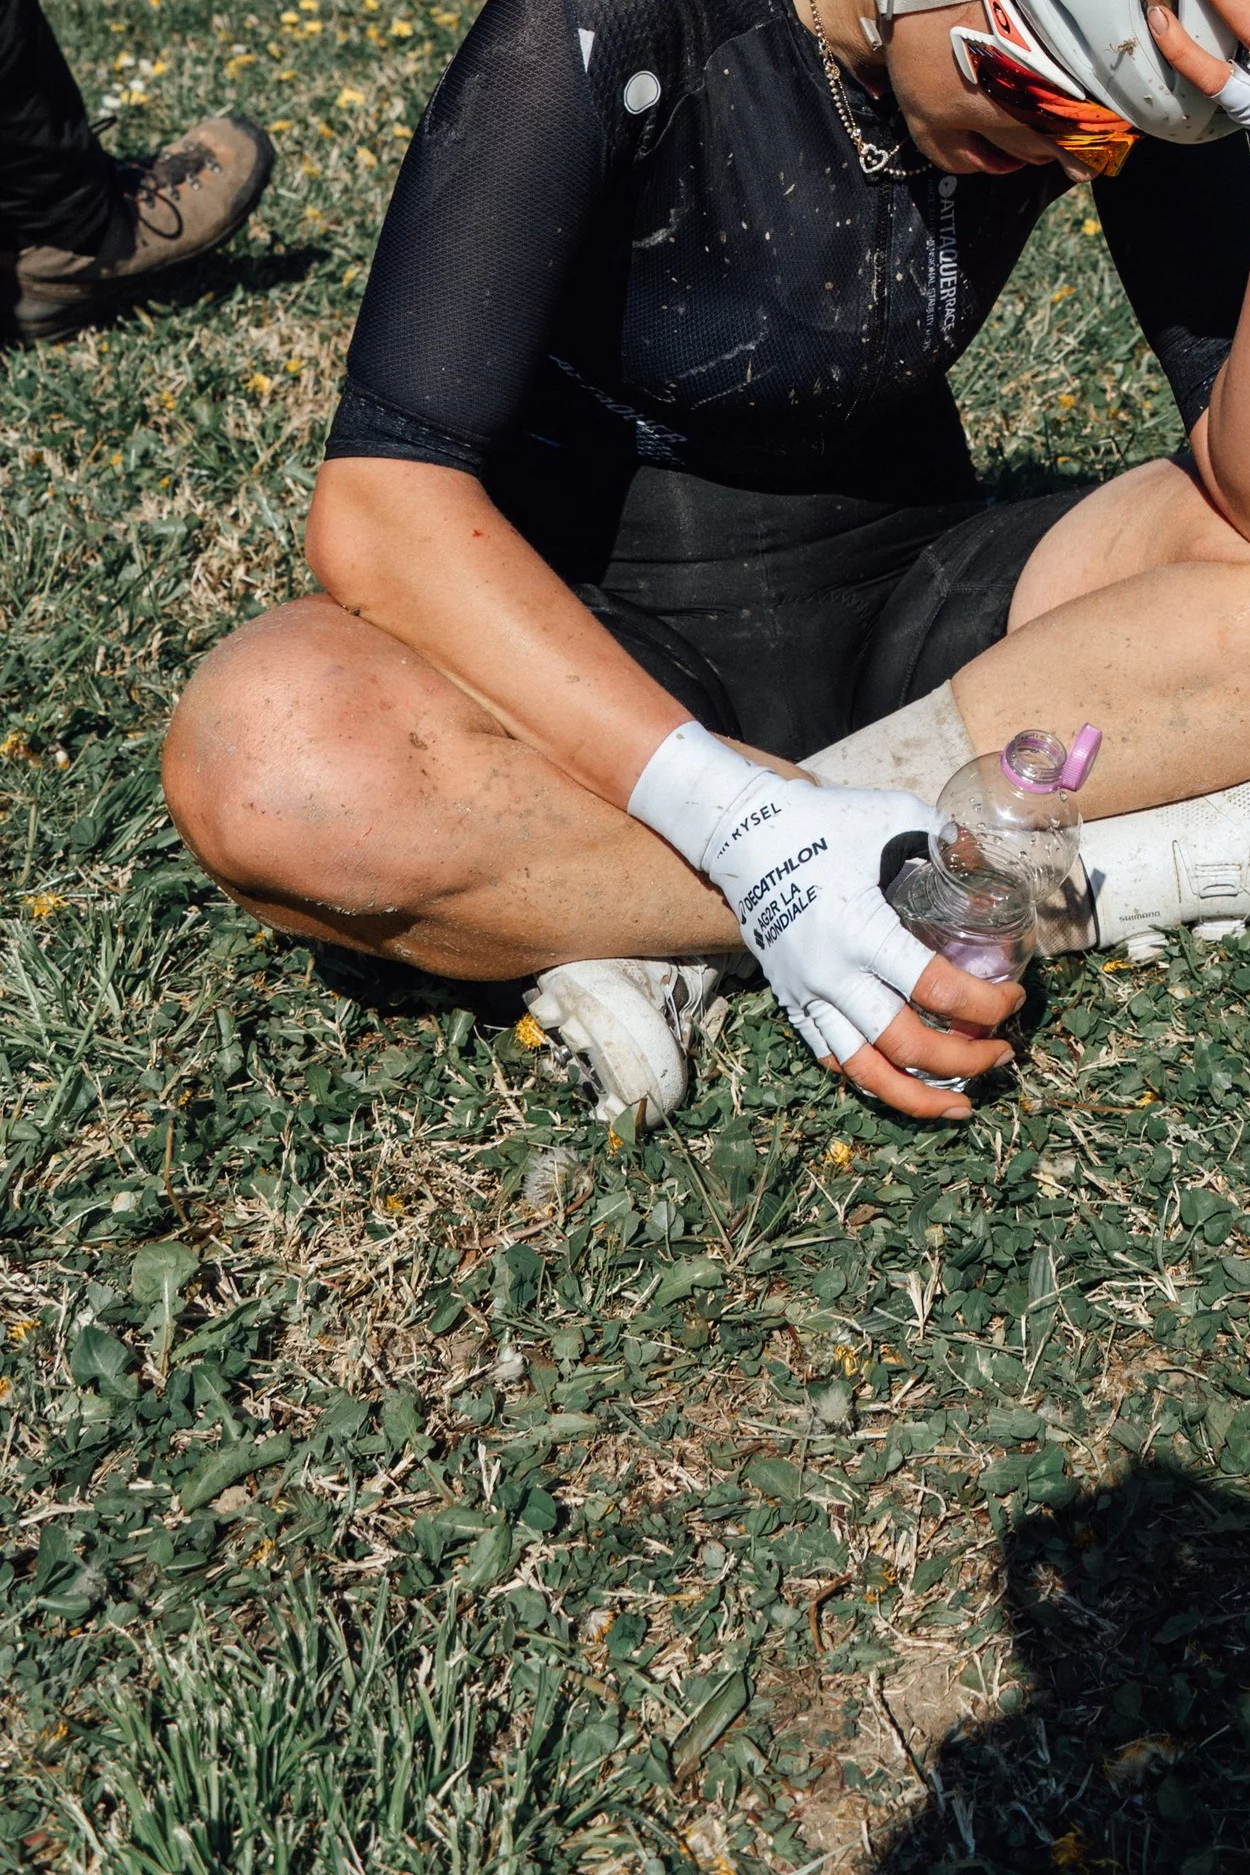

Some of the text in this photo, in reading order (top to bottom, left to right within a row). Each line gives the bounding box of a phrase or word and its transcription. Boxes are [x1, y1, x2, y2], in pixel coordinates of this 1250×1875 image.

[938, 199, 958, 300] ATTAQUER
[745, 837, 828, 912] DECATHLON
[757, 882, 801, 932] AG2R LA
[764, 885, 817, 947] MONDIALE
[1119, 911, 1160, 922] SHIMANO
